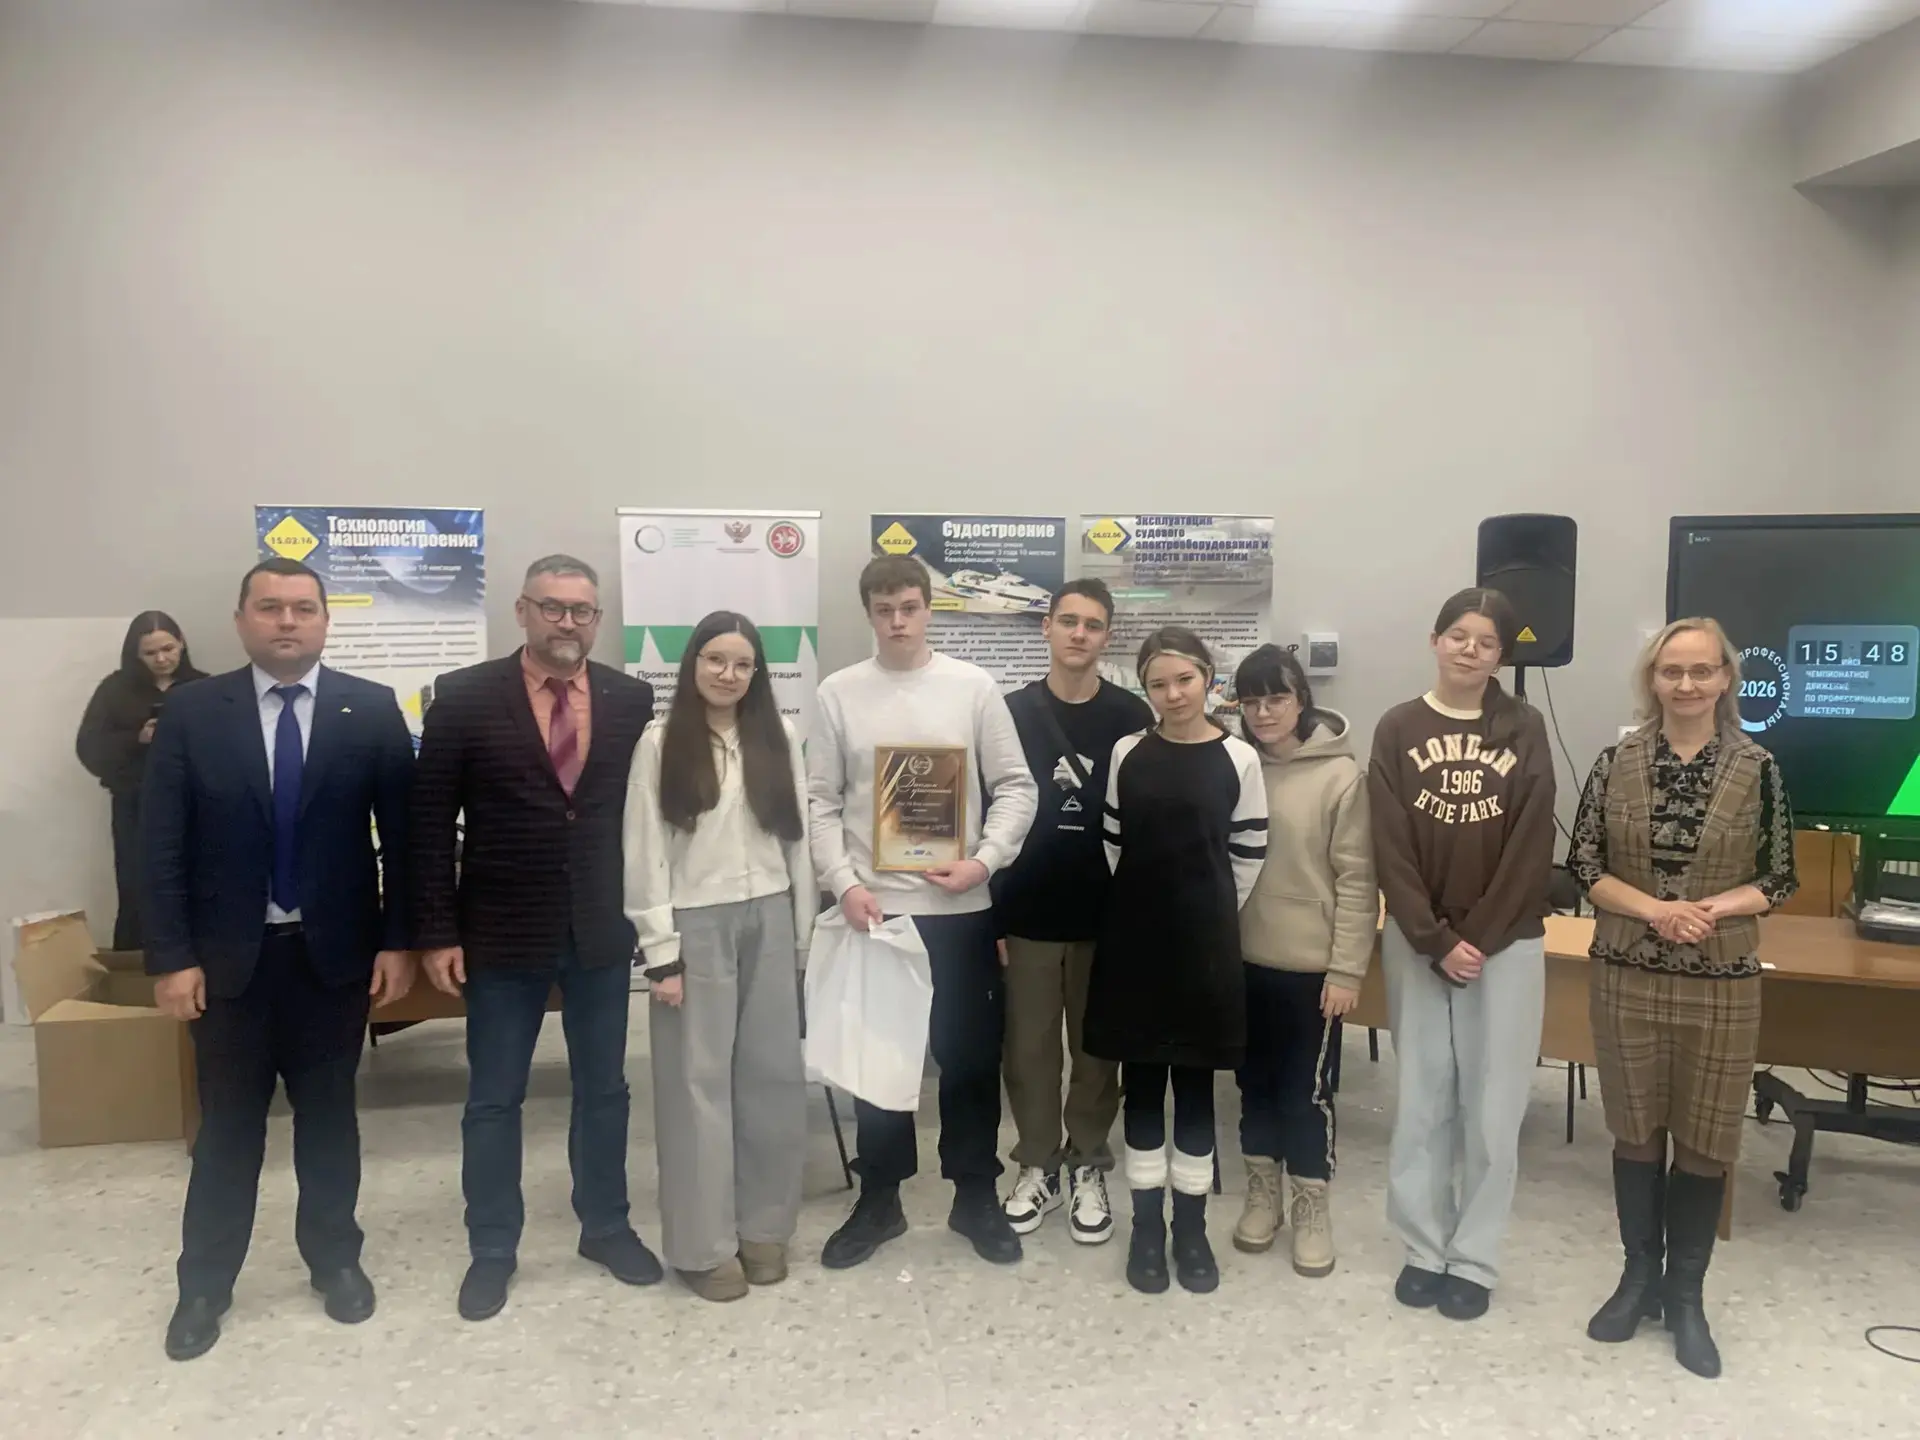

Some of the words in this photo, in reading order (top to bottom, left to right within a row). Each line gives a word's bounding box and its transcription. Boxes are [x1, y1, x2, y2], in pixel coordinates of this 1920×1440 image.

[327, 516, 426, 533] Технология
[1135, 515, 1213, 526] Эксплуатация
[942, 520, 1056, 539] Судостроение
[1135, 529, 1185, 539] судового
[329, 532, 478, 548] машиностроения
[1135, 539, 1259, 550] электрооборудования
[1261, 540, 1269, 549] и
[1135, 553, 1180, 563] средств
[1182, 552, 1248, 562] автоматики
[1805, 670, 1870, 679] ЧЕМПИОНАТНОЕ
[1738, 680, 1777, 698] 2026
[1805, 682, 1850, 691] ДВИЖЕНИЕ
[1818, 695, 1910, 704] ПРОФЕССИОНАЛЬНОМУ
[1804, 706, 1856, 715] МАСТЕРСТВУ
[1440, 768, 1484, 795] 1986
[1413, 788, 1457, 824] HYDE
[1460, 795, 1504, 823] PARK
